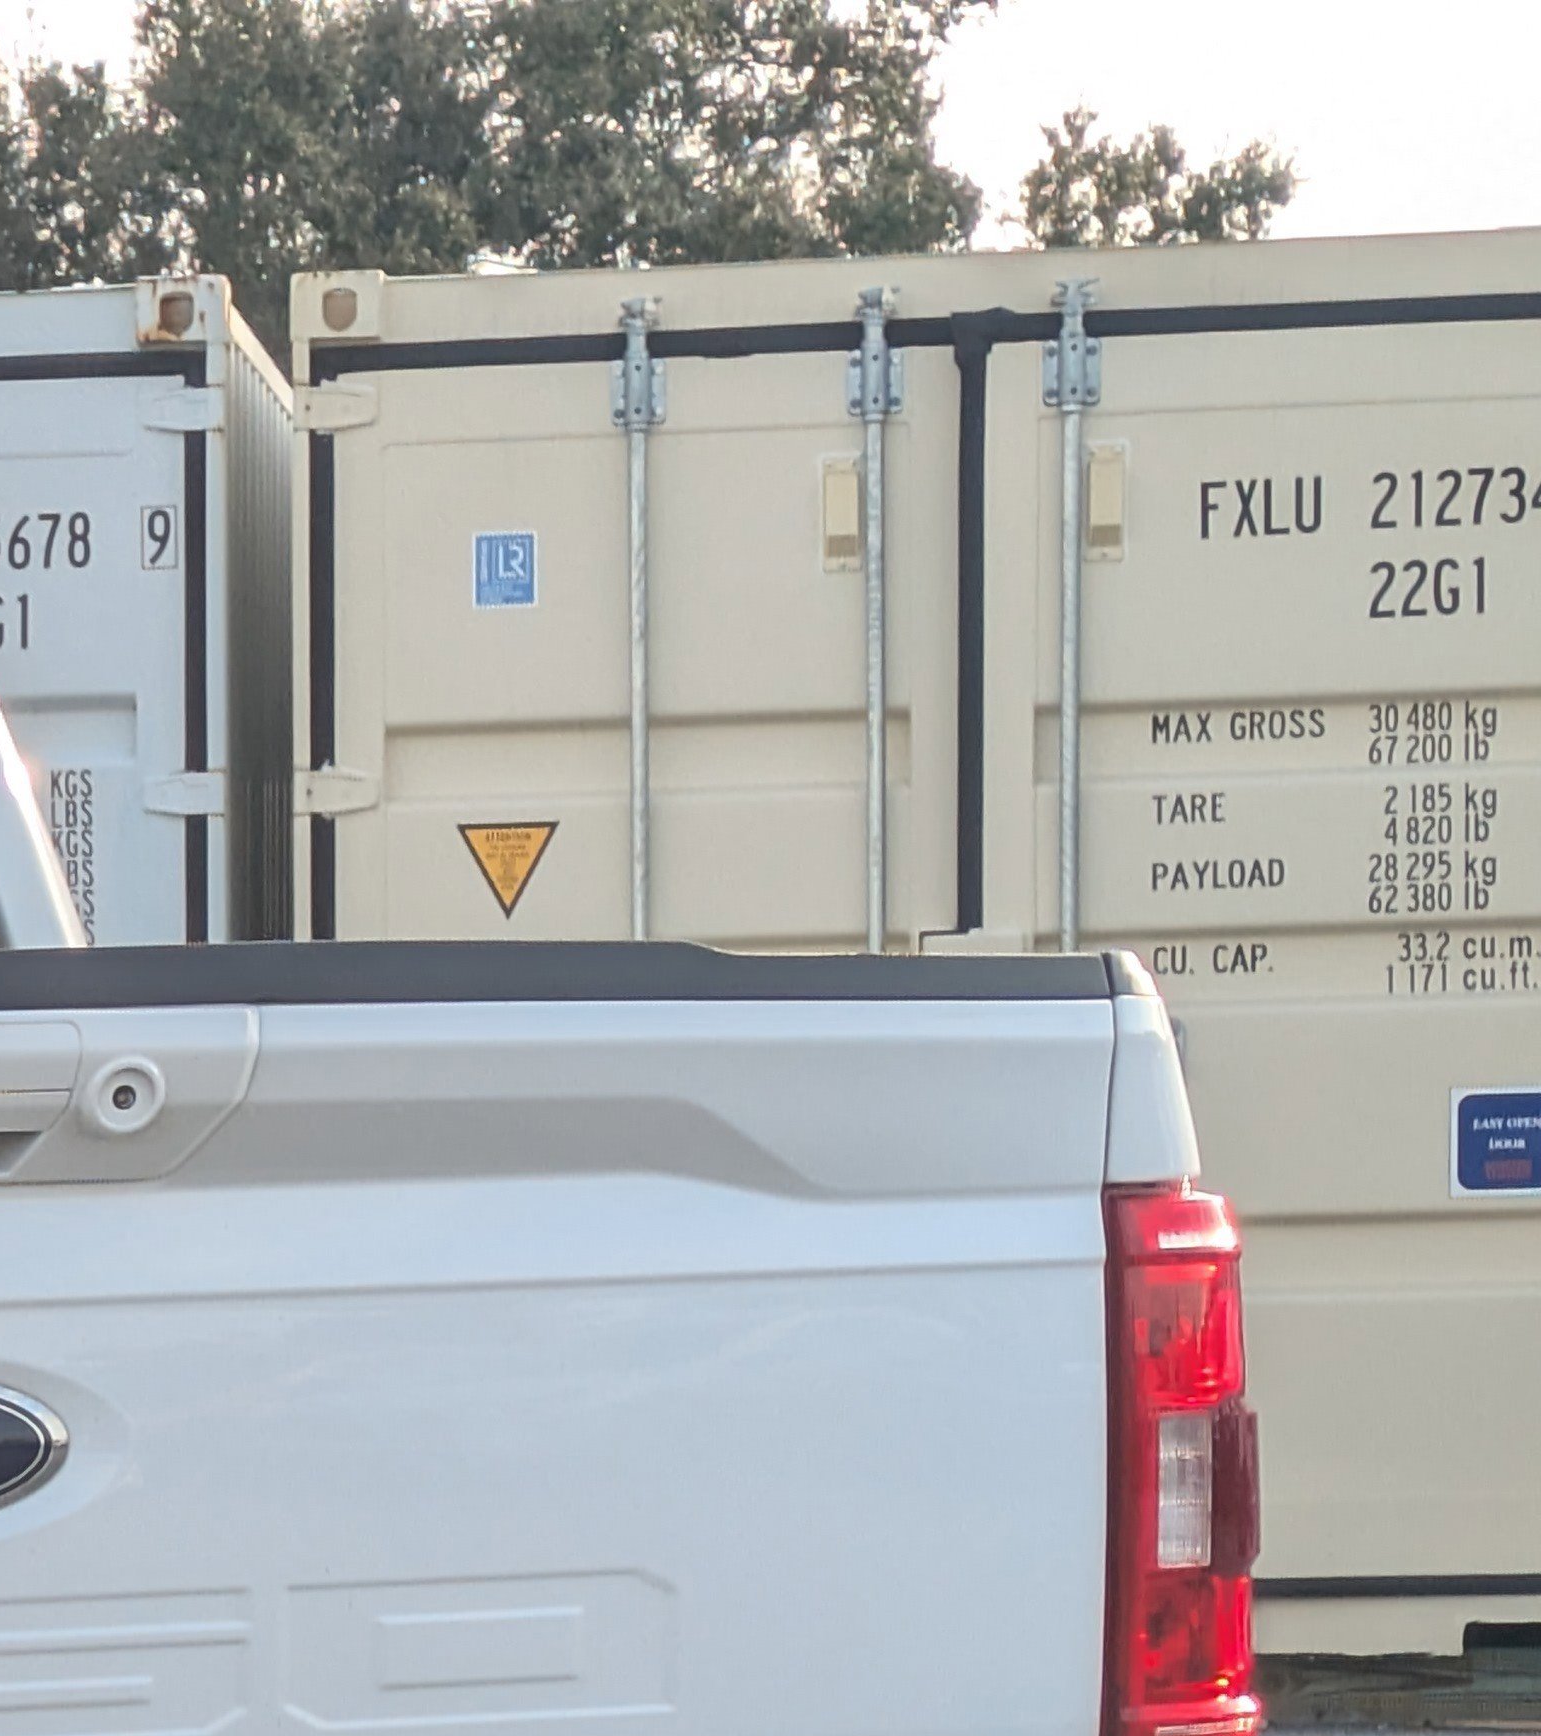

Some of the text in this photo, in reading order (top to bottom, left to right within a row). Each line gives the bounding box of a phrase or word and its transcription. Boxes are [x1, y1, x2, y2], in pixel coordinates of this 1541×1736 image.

[1200, 476, 1322, 539] FXLU
[147, 509, 172, 565] 9
[1369, 556, 1486, 619] 22G1
[1151, 711, 1213, 744] MAX
[1229, 709, 1326, 741] GROSS
[1464, 700, 1498, 737] kg
[1464, 732, 1490, 762] lb
[50, 769, 93, 799] KGS
[1152, 792, 1227, 825] TARE
[1464, 782, 1498, 818] kg
[51, 799, 93, 829] LBS
[1464, 813, 1490, 844] lb
[66, 860, 94, 887] BS
[1151, 857, 1285, 891] PAYLOAD
[1464, 850, 1498, 886] kg
[1464, 881, 1490, 910] lb
[1152, 945, 1195, 975] CU.
[1212, 943, 1275, 974] CAP.
[1398, 931, 1451, 962] 33.2
